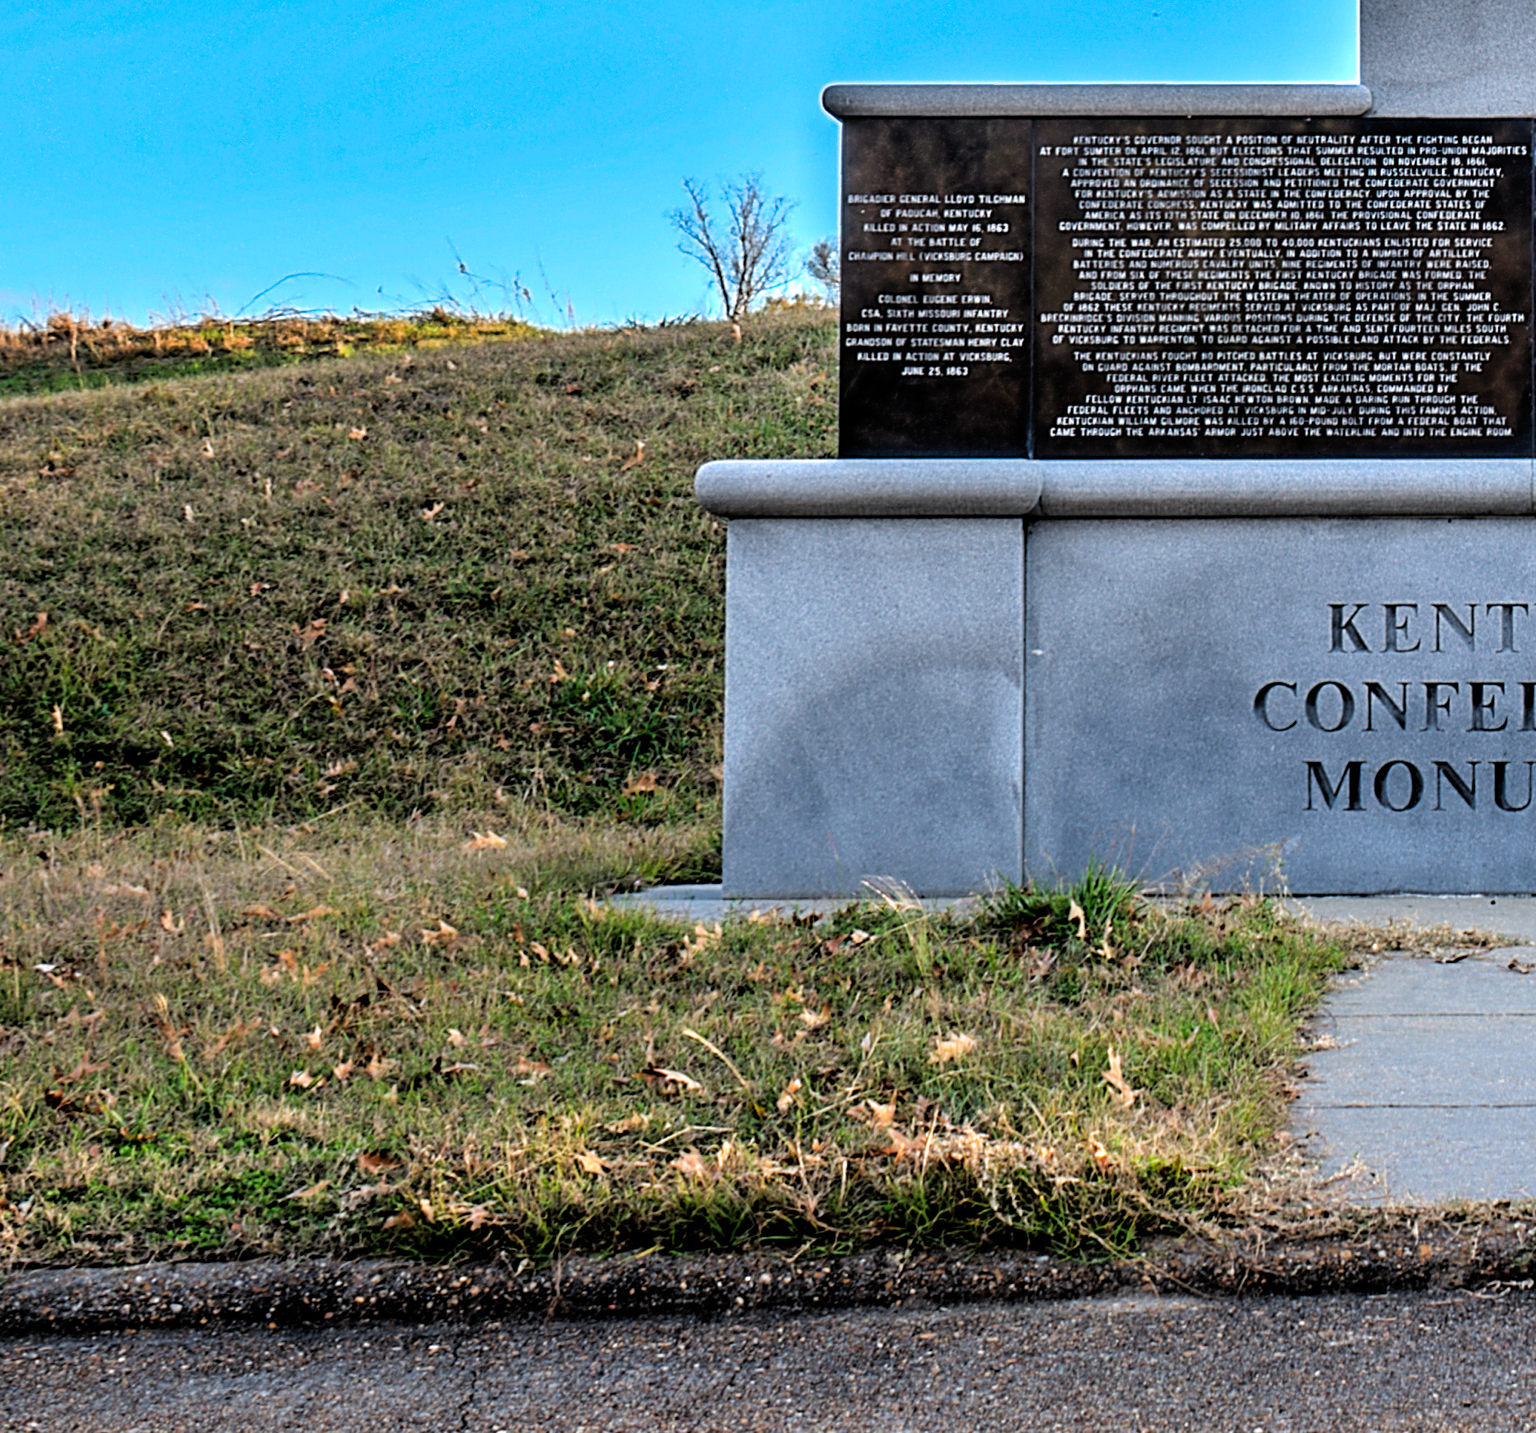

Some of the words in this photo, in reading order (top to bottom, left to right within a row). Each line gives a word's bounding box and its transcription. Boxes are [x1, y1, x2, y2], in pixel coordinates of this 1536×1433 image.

[1073, 136, 1131, 145] KENTUCKY'S
[1134, 136, 1182, 145] GOVERNOR
[1185, 136, 1222, 145] SOUGHT
[1225, 136, 1233, 145] A
[1235, 136, 1278, 145] POSITION
[1280, 136, 1293, 145] OF
[1296, 136, 1356, 145] NEUTRALITY
[1360, 136, 1391, 145] AFTER
[1395, 136, 1413, 145] THE
[1416, 136, 1459, 145] FIGHTING
[1461, 136, 1493, 145] BEGAN
[1039, 147, 1052, 156] AT
[1054, 147, 1079, 156] FORT
[1083, 147, 1122, 156] SUMTER
[1124, 147, 1138, 156] ON
[1140, 147, 1167, 156] APRIL
[1209, 147, 1229, 156] BUT
[1232, 147, 1283, 156] ELECTIONS
[1287, 147, 1311, 156] THAT
[1315, 147, 1354, 156] SUMMER
[1357, 147, 1404, 156] RESULTED
[1407, 147, 1416, 156] IN
[1419, 147, 1469, 156] PRO-UNION
[1471, 147, 1528, 156] MAJORITIES
[847, 195, 896, 204] BRIGADIER
[898, 195, 942, 204] GENERAL
[944, 195, 975, 204] LLOYD
[978, 195, 1026, 204] TILGHMAN
[881, 210, 893, 218] OF
[943, 210, 993, 218] KENTUCKY
[863, 224, 896, 233] KILLED
[898, 224, 909, 233] IN
[911, 224, 946, 233] ACTION
[948, 224, 969, 233] MAY
[986, 224, 1009, 233] 1863
[890, 238, 903, 247] AT
[907, 238, 926, 247] THE
[928, 238, 966, 247] BATTLE
[969, 238, 982, 247] OF
[848, 252, 893, 261] CHAMPION
[896, 252, 915, 261] HILL
[919, 252, 972, 261] (VICKSBURG
[975, 252, 1024, 261] CAMPAIGN)
[909, 274, 919, 282] IN
[921, 274, 961, 282] MEMORY
[878, 295, 918, 304] COLONEL
[923, 295, 958, 304] EUGENE
[886, 310, 915, 318] SIXTH
[917, 310, 961, 318] MISSOURI
[963, 310, 1009, 318] INFANTRY
[846, 324, 871, 333] BORN
[873, 324, 883, 333] IN
[886, 324, 929, 333] FAYETTE
[975, 324, 1024, 333] KENTUCKY
[845, 338, 893, 347] GRANDSON
[895, 338, 907, 347] OF
[910, 338, 965, 347] STATESMAN
[967, 338, 998, 347] HENRY
[1000, 338, 1025, 347] CLAY
[857, 353, 890, 362] KILLED
[892, 353, 902, 362] IN
[905, 353, 940, 362] ACTION
[942, 353, 955, 362] AT
[901, 367, 925, 376] JUNE
[946, 367, 969, 376] 1863
[1049, 428, 1076, 437] CAME
[1080, 428, 1122, 437] THROUGH
[1126, 428, 1144, 437] THE
[1204, 428, 1236, 437] ARMOR
[1241, 428, 1263, 437] JUST
[1268, 428, 1298, 437] ABOVE
[1304, 428, 1321, 437] THE
[1326, 428, 1376, 437] WATERLINE
[1381, 428, 1400, 437] AND
[1403, 428, 1425, 437] INTO
[1429, 428, 1446, 437] THE
[1450, 428, 1482, 437] ENGINE
